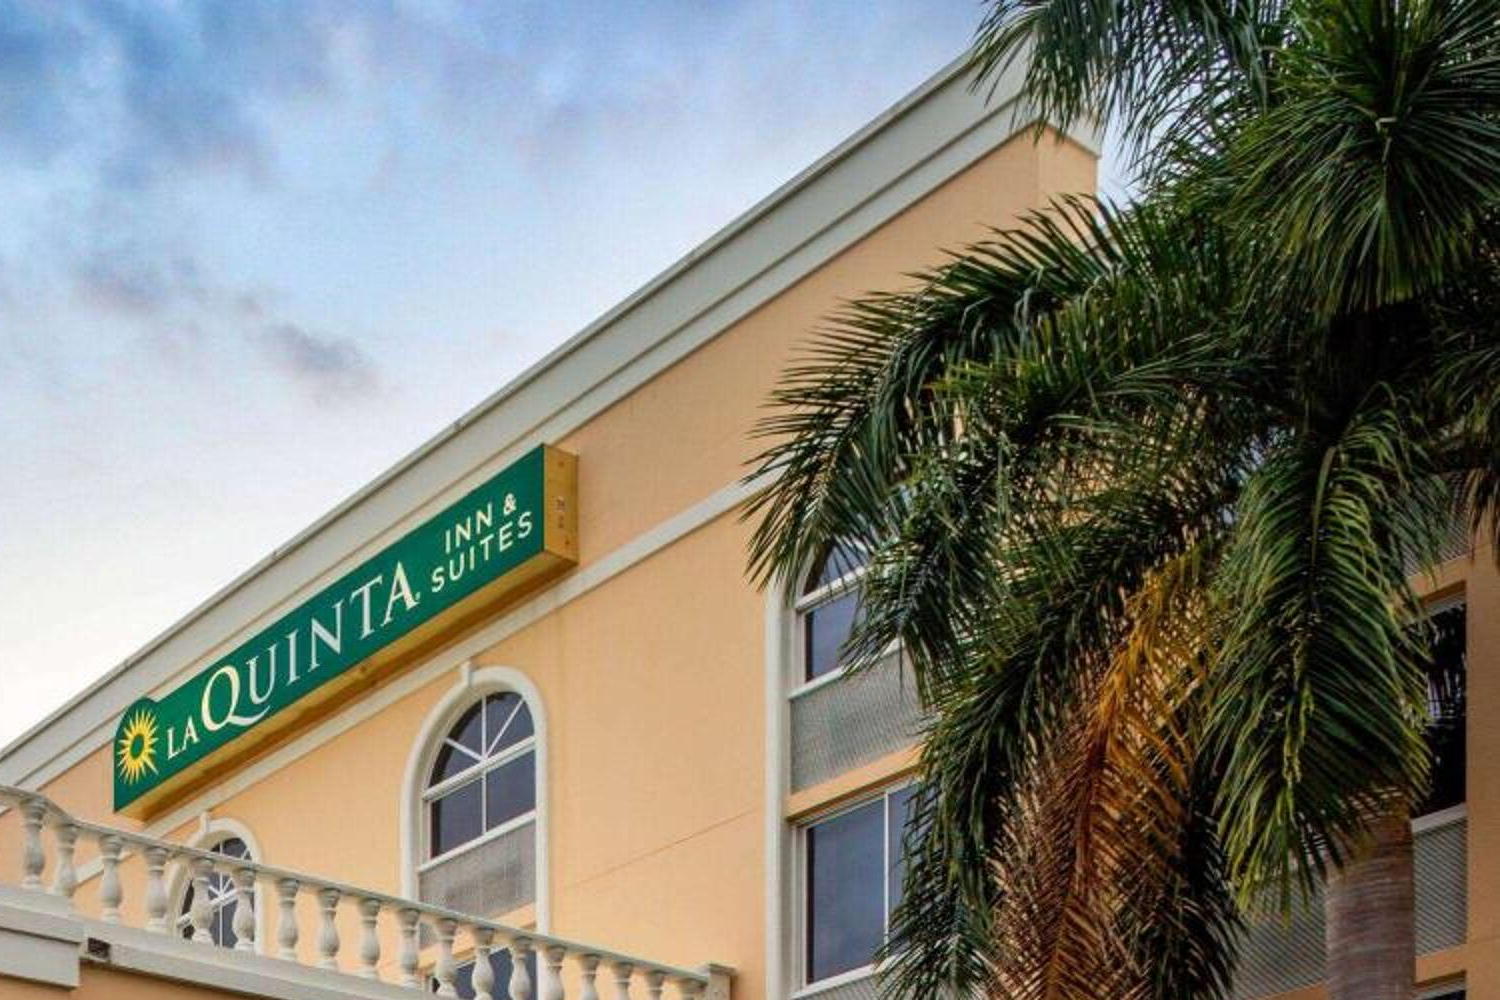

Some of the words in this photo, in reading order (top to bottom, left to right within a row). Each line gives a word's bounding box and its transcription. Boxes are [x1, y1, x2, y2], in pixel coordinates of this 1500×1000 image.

[431, 511, 533, 593] SUITES
[445, 501, 493, 554] INN
[503, 493, 517, 516] &
[167, 715, 200, 760] LA
[201, 561, 420, 732] QUINTA
